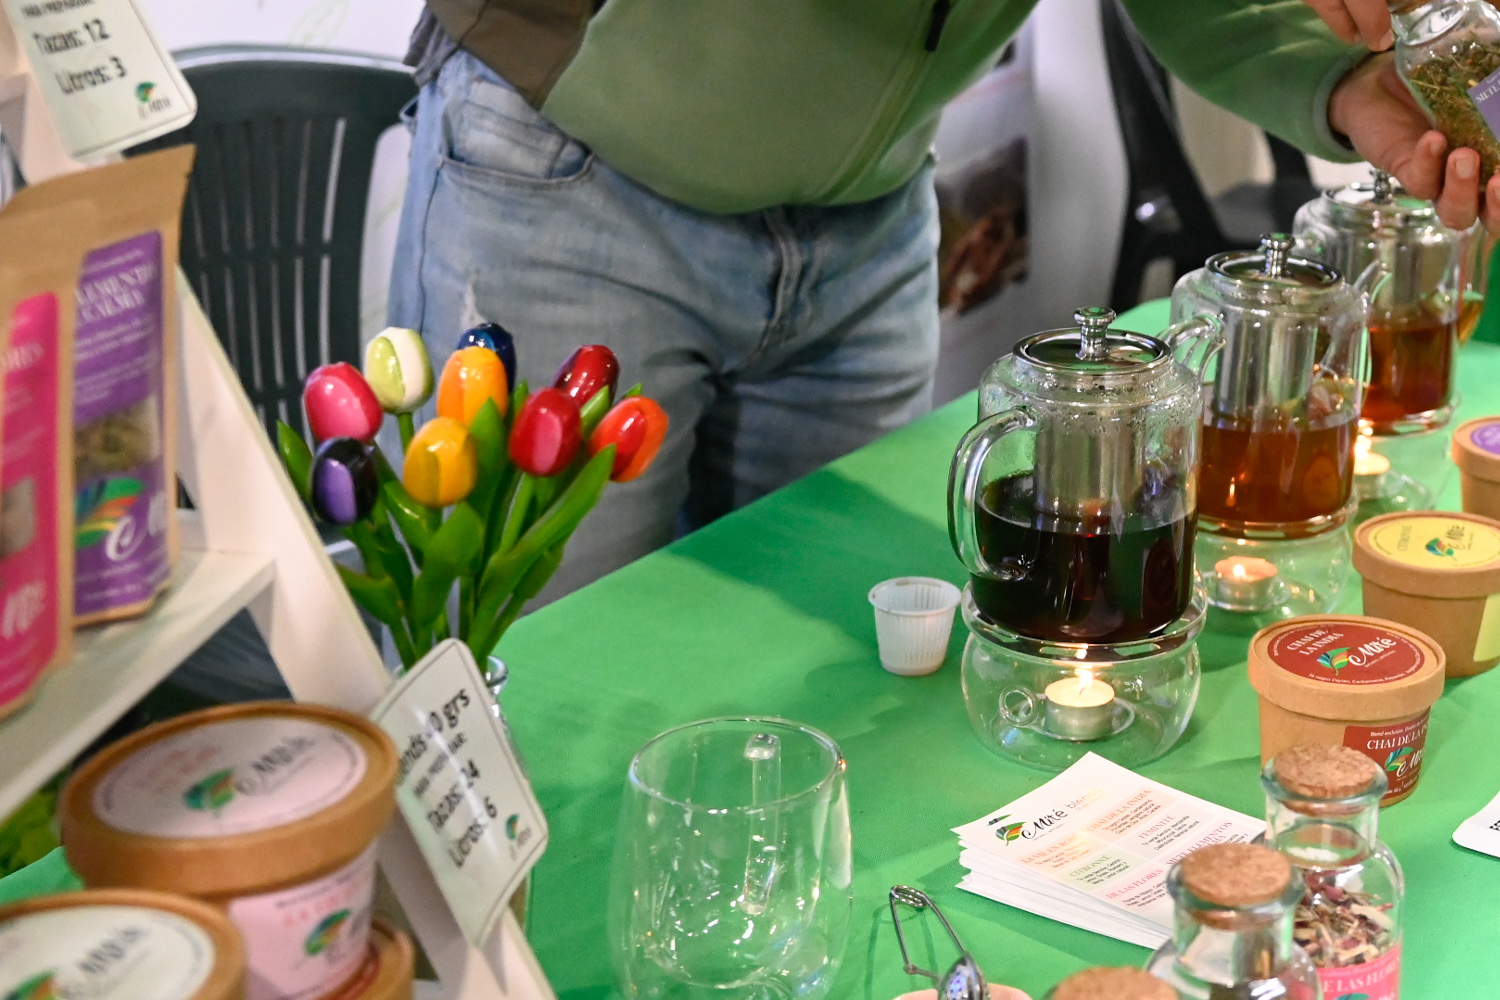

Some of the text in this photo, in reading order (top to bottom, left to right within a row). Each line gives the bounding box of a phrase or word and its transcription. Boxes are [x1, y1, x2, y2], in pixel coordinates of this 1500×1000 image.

[83, 18, 110, 43] 12
[111, 56, 128, 79] 3
[1286, 635, 1314, 650] CHAI
[1299, 646, 1318, 655] LA
[1349, 636, 1397, 666] Mité
[442, 688, 470, 729] grs
[1366, 738, 1395, 750] CHAI
[1397, 733, 1411, 746] DE
[484, 795, 498, 820] 6
[1127, 789, 1151, 806] INDIA
[1021, 808, 1068, 840] Mité
[1132, 869, 1164, 887] FLORES
